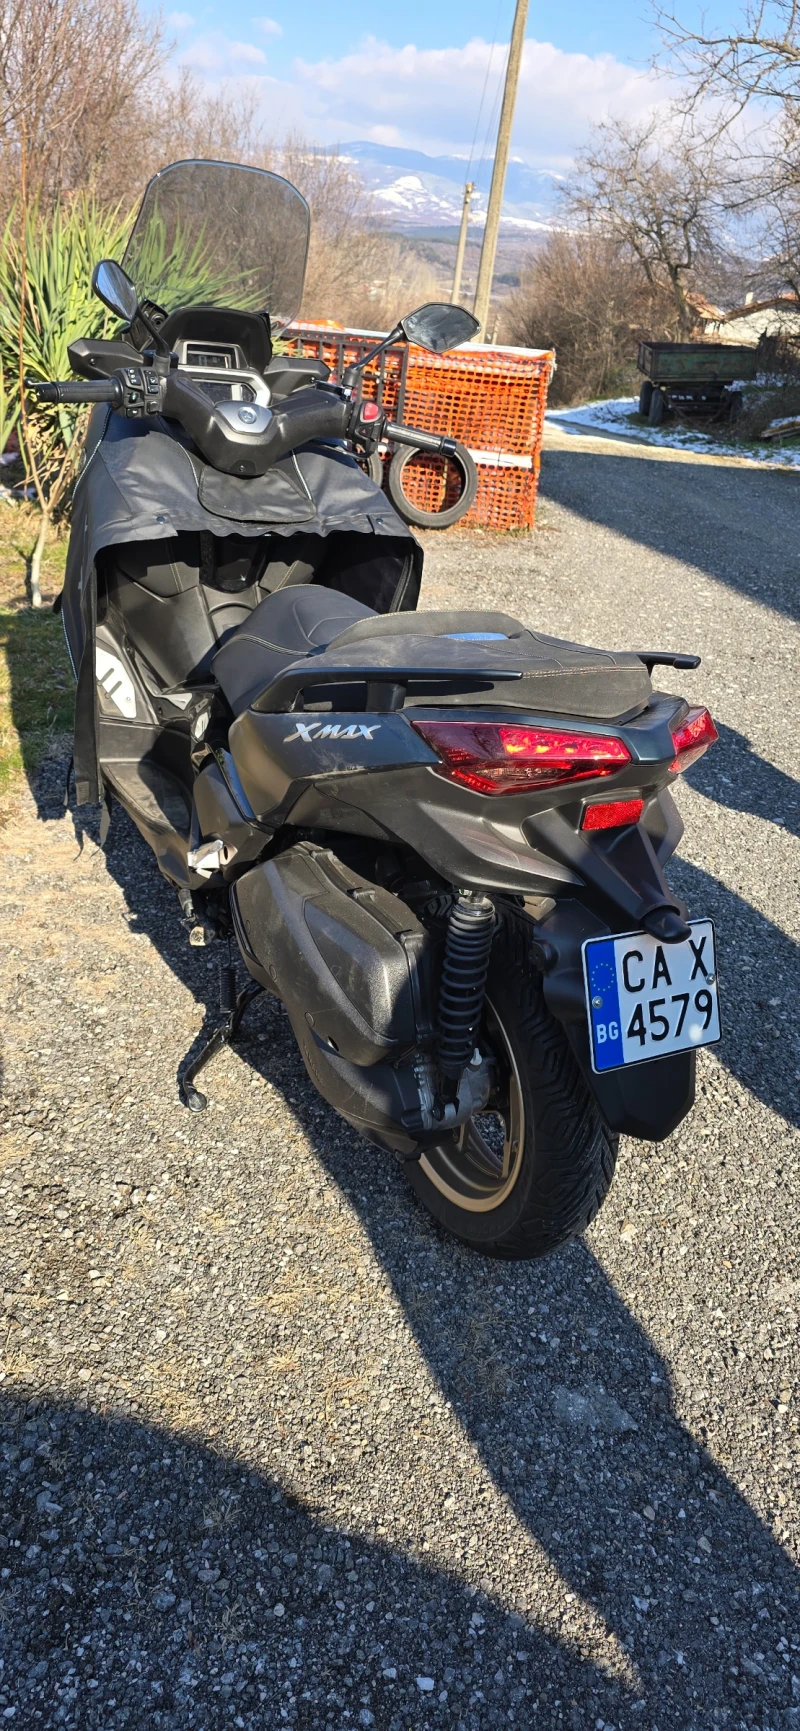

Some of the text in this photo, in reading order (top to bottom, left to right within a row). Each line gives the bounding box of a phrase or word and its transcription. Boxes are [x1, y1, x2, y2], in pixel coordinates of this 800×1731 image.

[283, 722, 382, 742] XMAX
[622, 936, 709, 993] CA X
[596, 1021, 619, 1044] BG
[626, 989, 713, 1046] 4579
